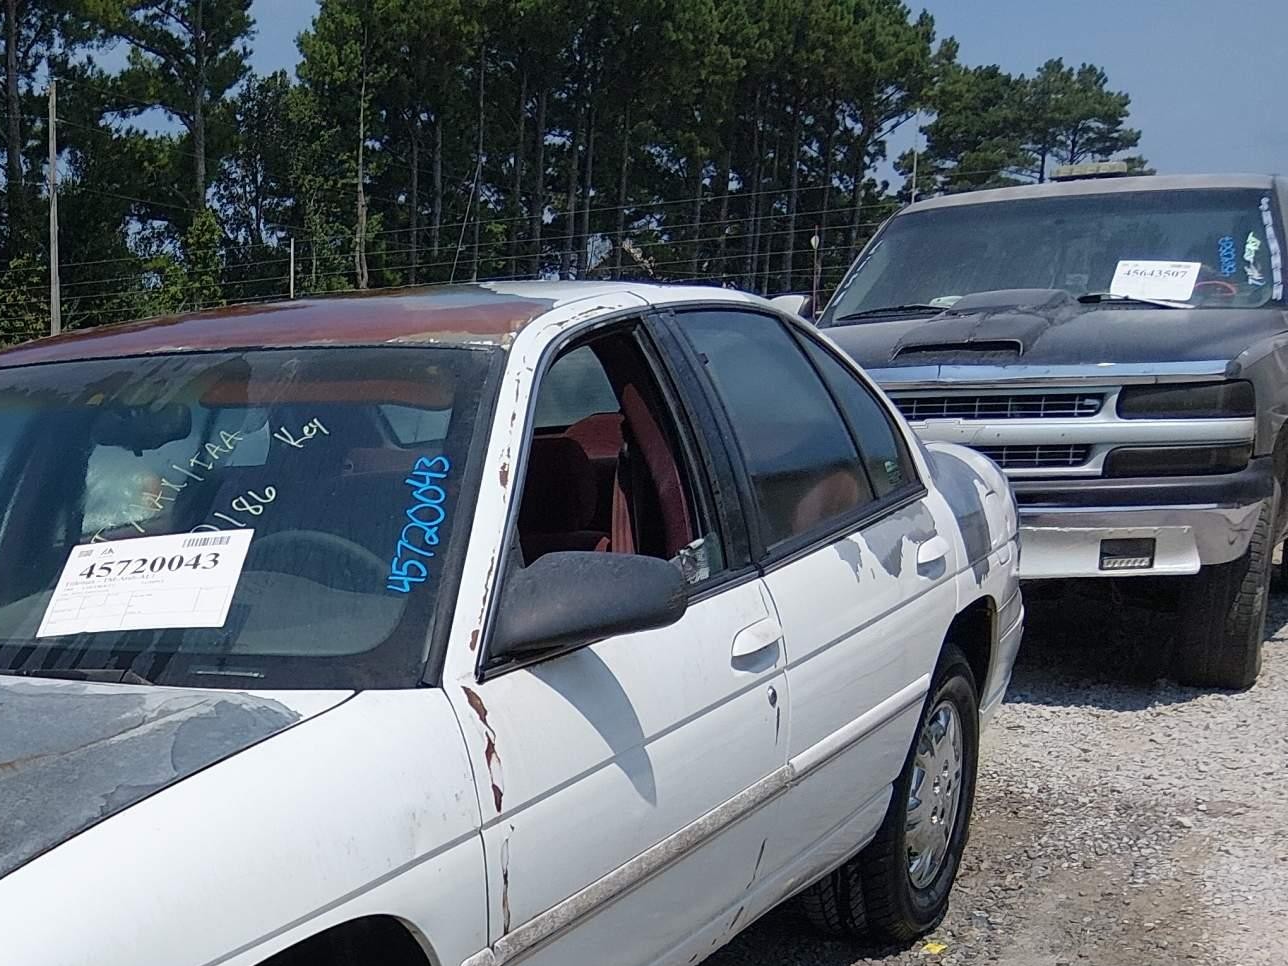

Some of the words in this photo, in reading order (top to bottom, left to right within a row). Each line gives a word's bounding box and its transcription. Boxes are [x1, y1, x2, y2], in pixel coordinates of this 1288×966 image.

[274, 417, 330, 449] Key
[386, 456, 451, 593] 45720043
[79, 551, 221, 580] 45720043
